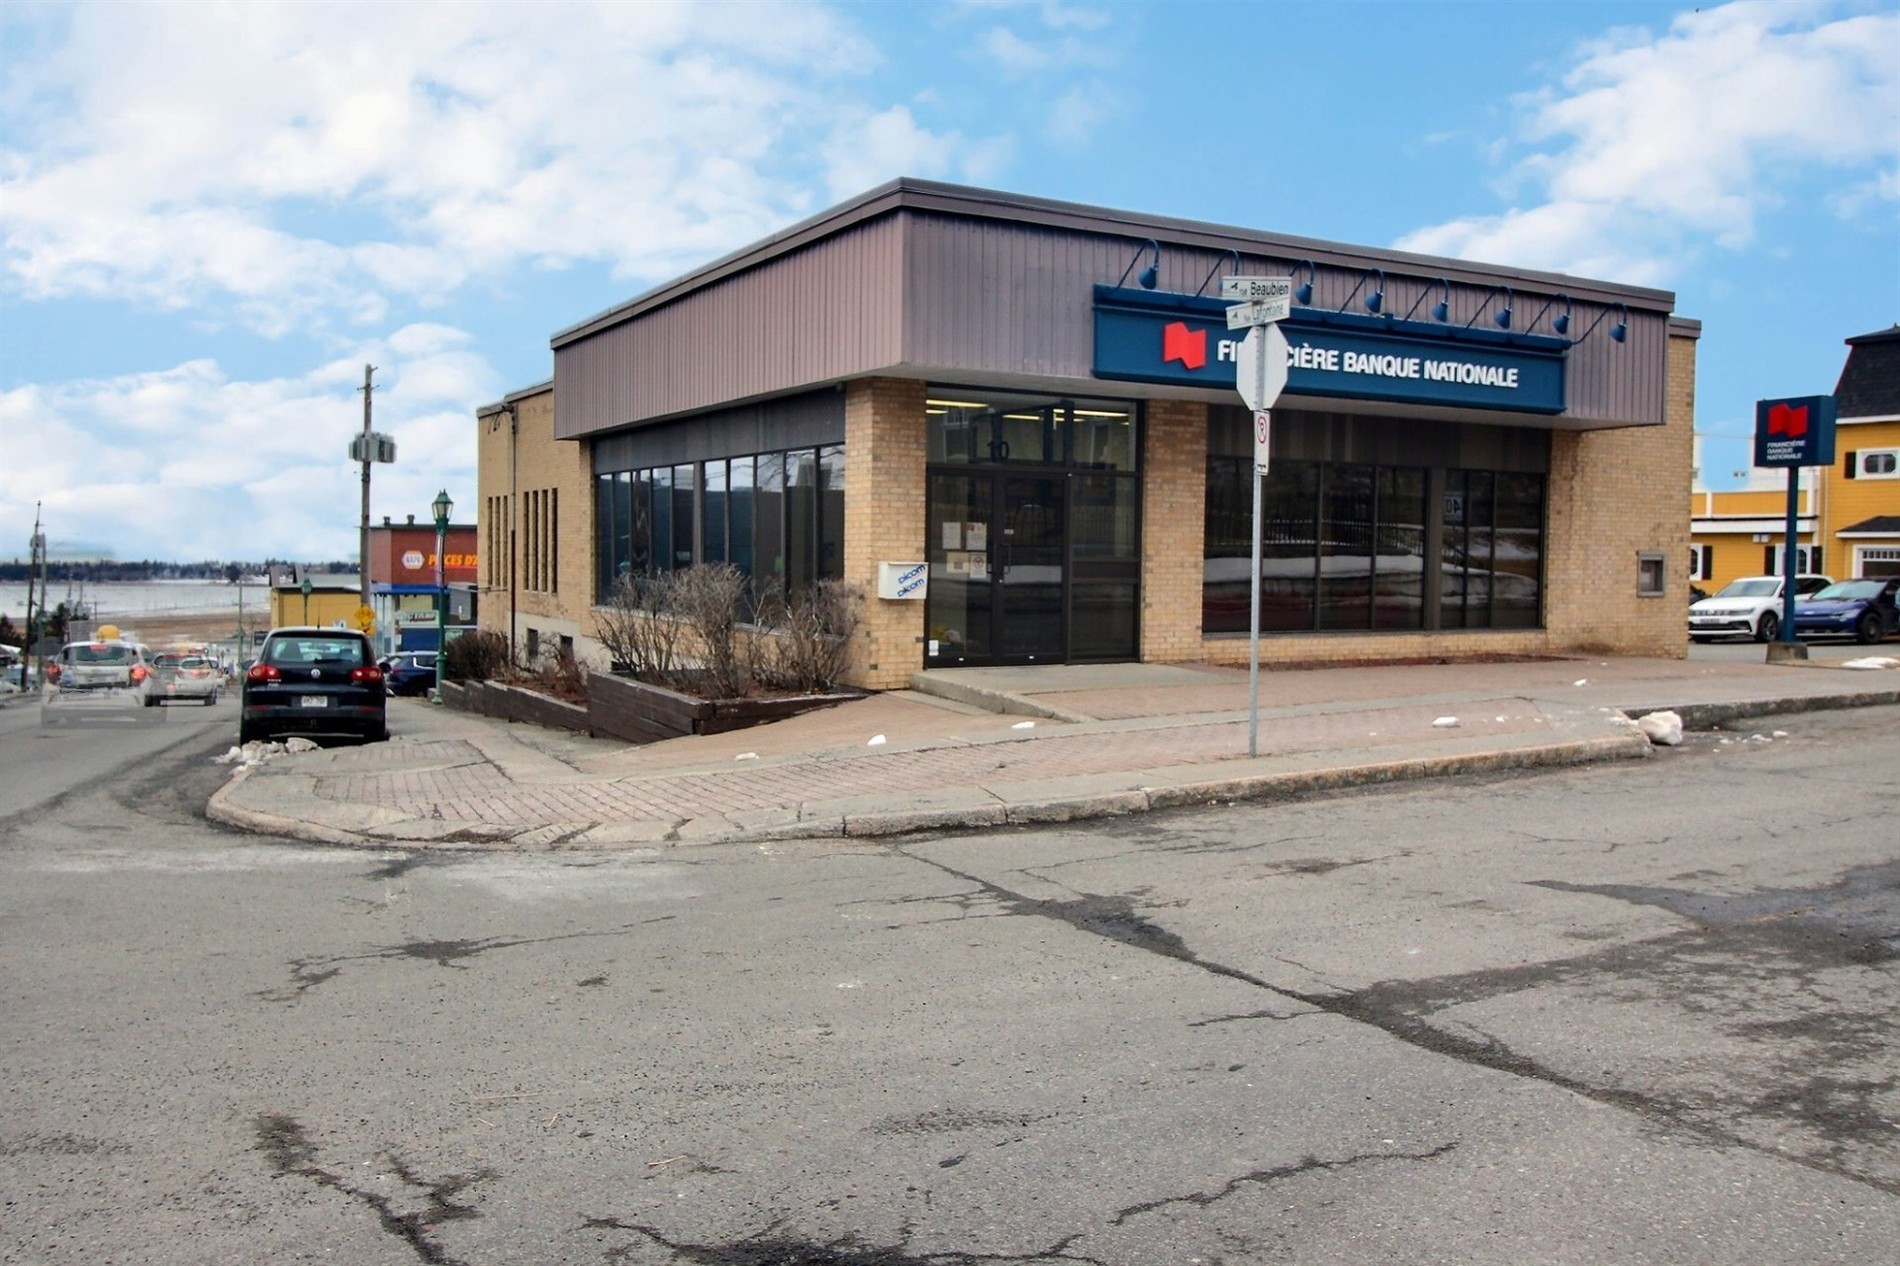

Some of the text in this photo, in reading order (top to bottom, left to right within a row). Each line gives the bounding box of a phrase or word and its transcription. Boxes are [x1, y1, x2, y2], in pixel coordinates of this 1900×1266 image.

[1250, 281, 1289, 296] Beaubien
[1217, 340, 1519, 388] FICIÈRE BANQUE NATIONALE
